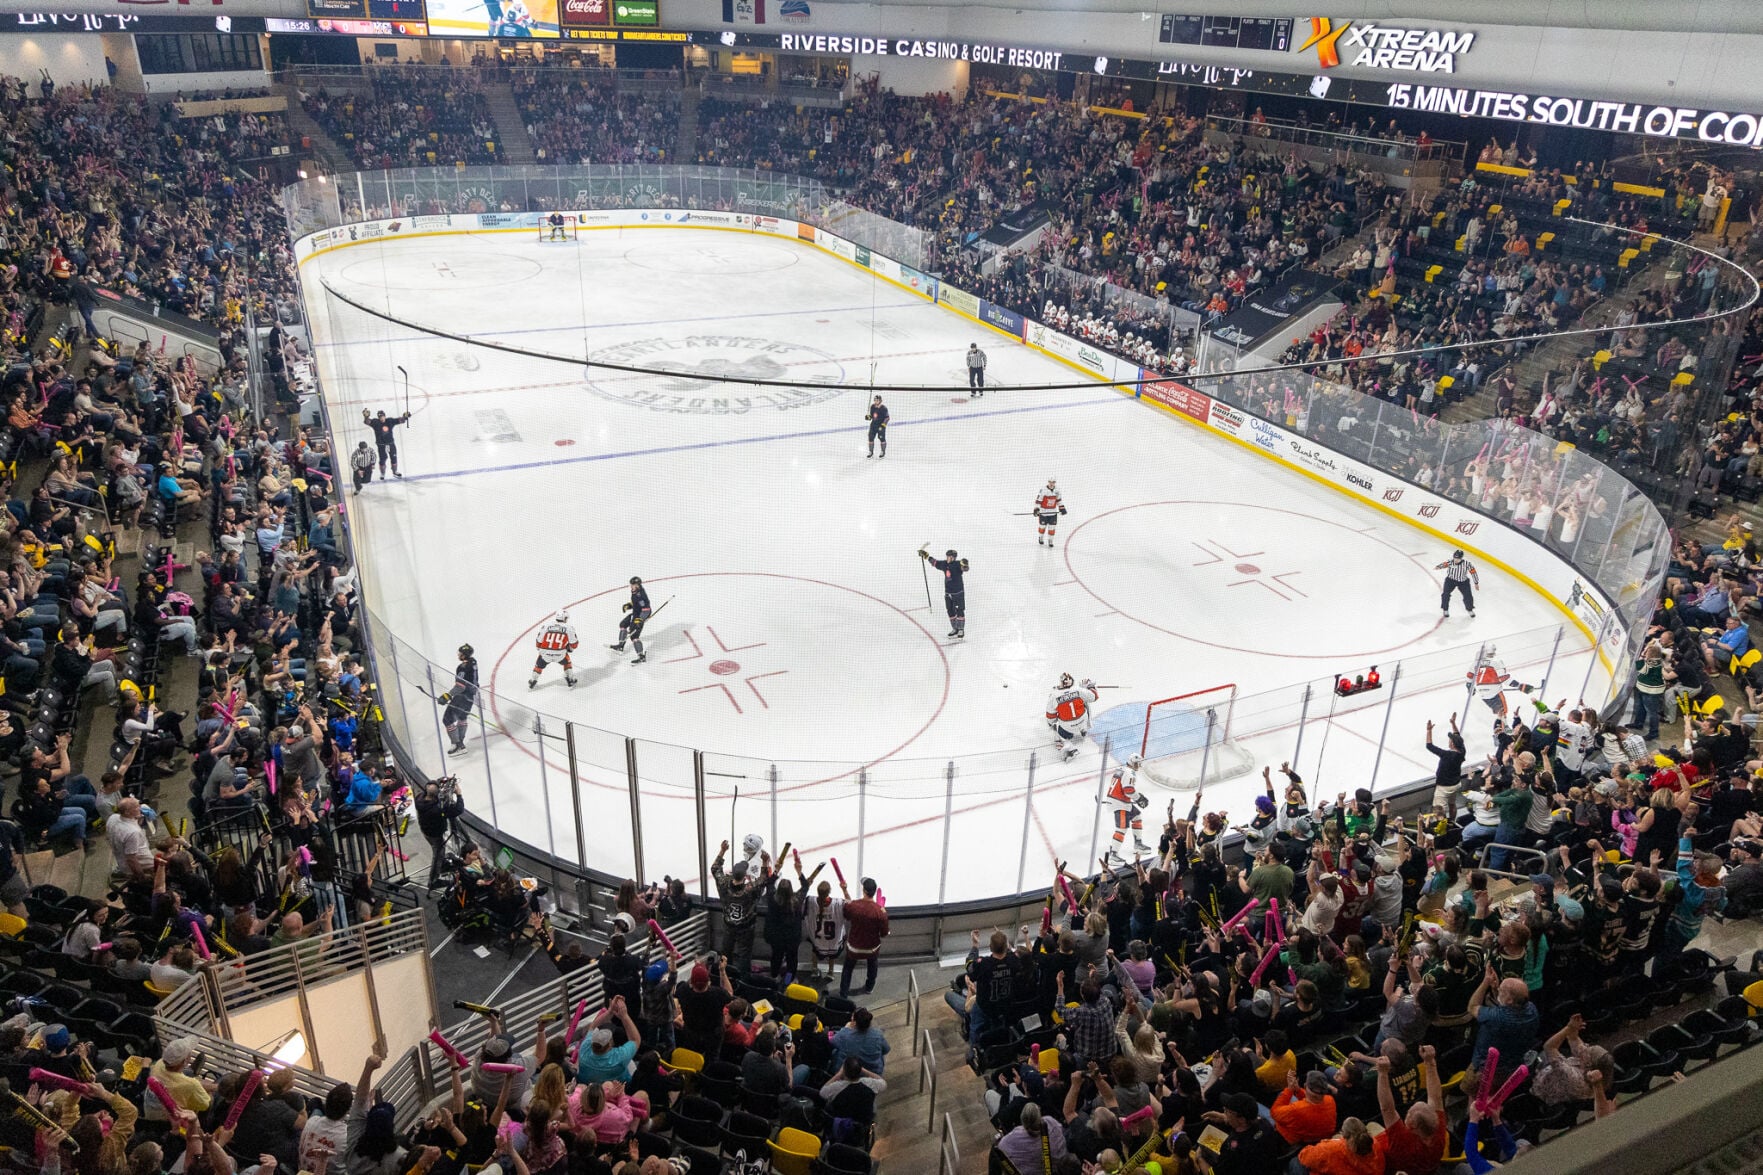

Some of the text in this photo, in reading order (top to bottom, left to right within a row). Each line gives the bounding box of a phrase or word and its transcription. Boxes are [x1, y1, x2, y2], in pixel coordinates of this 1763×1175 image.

[285, 20, 310, 31] 15:26
[1344, 24, 1476, 54] XTREAM
[780, 34, 1062, 71] RIVERSIDE CASINO & GOLF RESORT
[1351, 48, 1456, 74] ARENA
[1386, 84, 1412, 109] 15
[1414, 85, 1528, 121] MINUTES
[1531, 96, 1642, 132] SOUTH
[1643, 106, 1697, 138] OF
[361, 229, 385, 238] AFFILIATE
[1250, 418, 1285, 442] Culligan
[1255, 433, 1275, 449] Water
[1346, 473, 1373, 491] KOHLER
[546, 633, 566, 649] 44
[1069, 701, 1077, 718] 1
[992, 968, 1011, 978] SMITH
